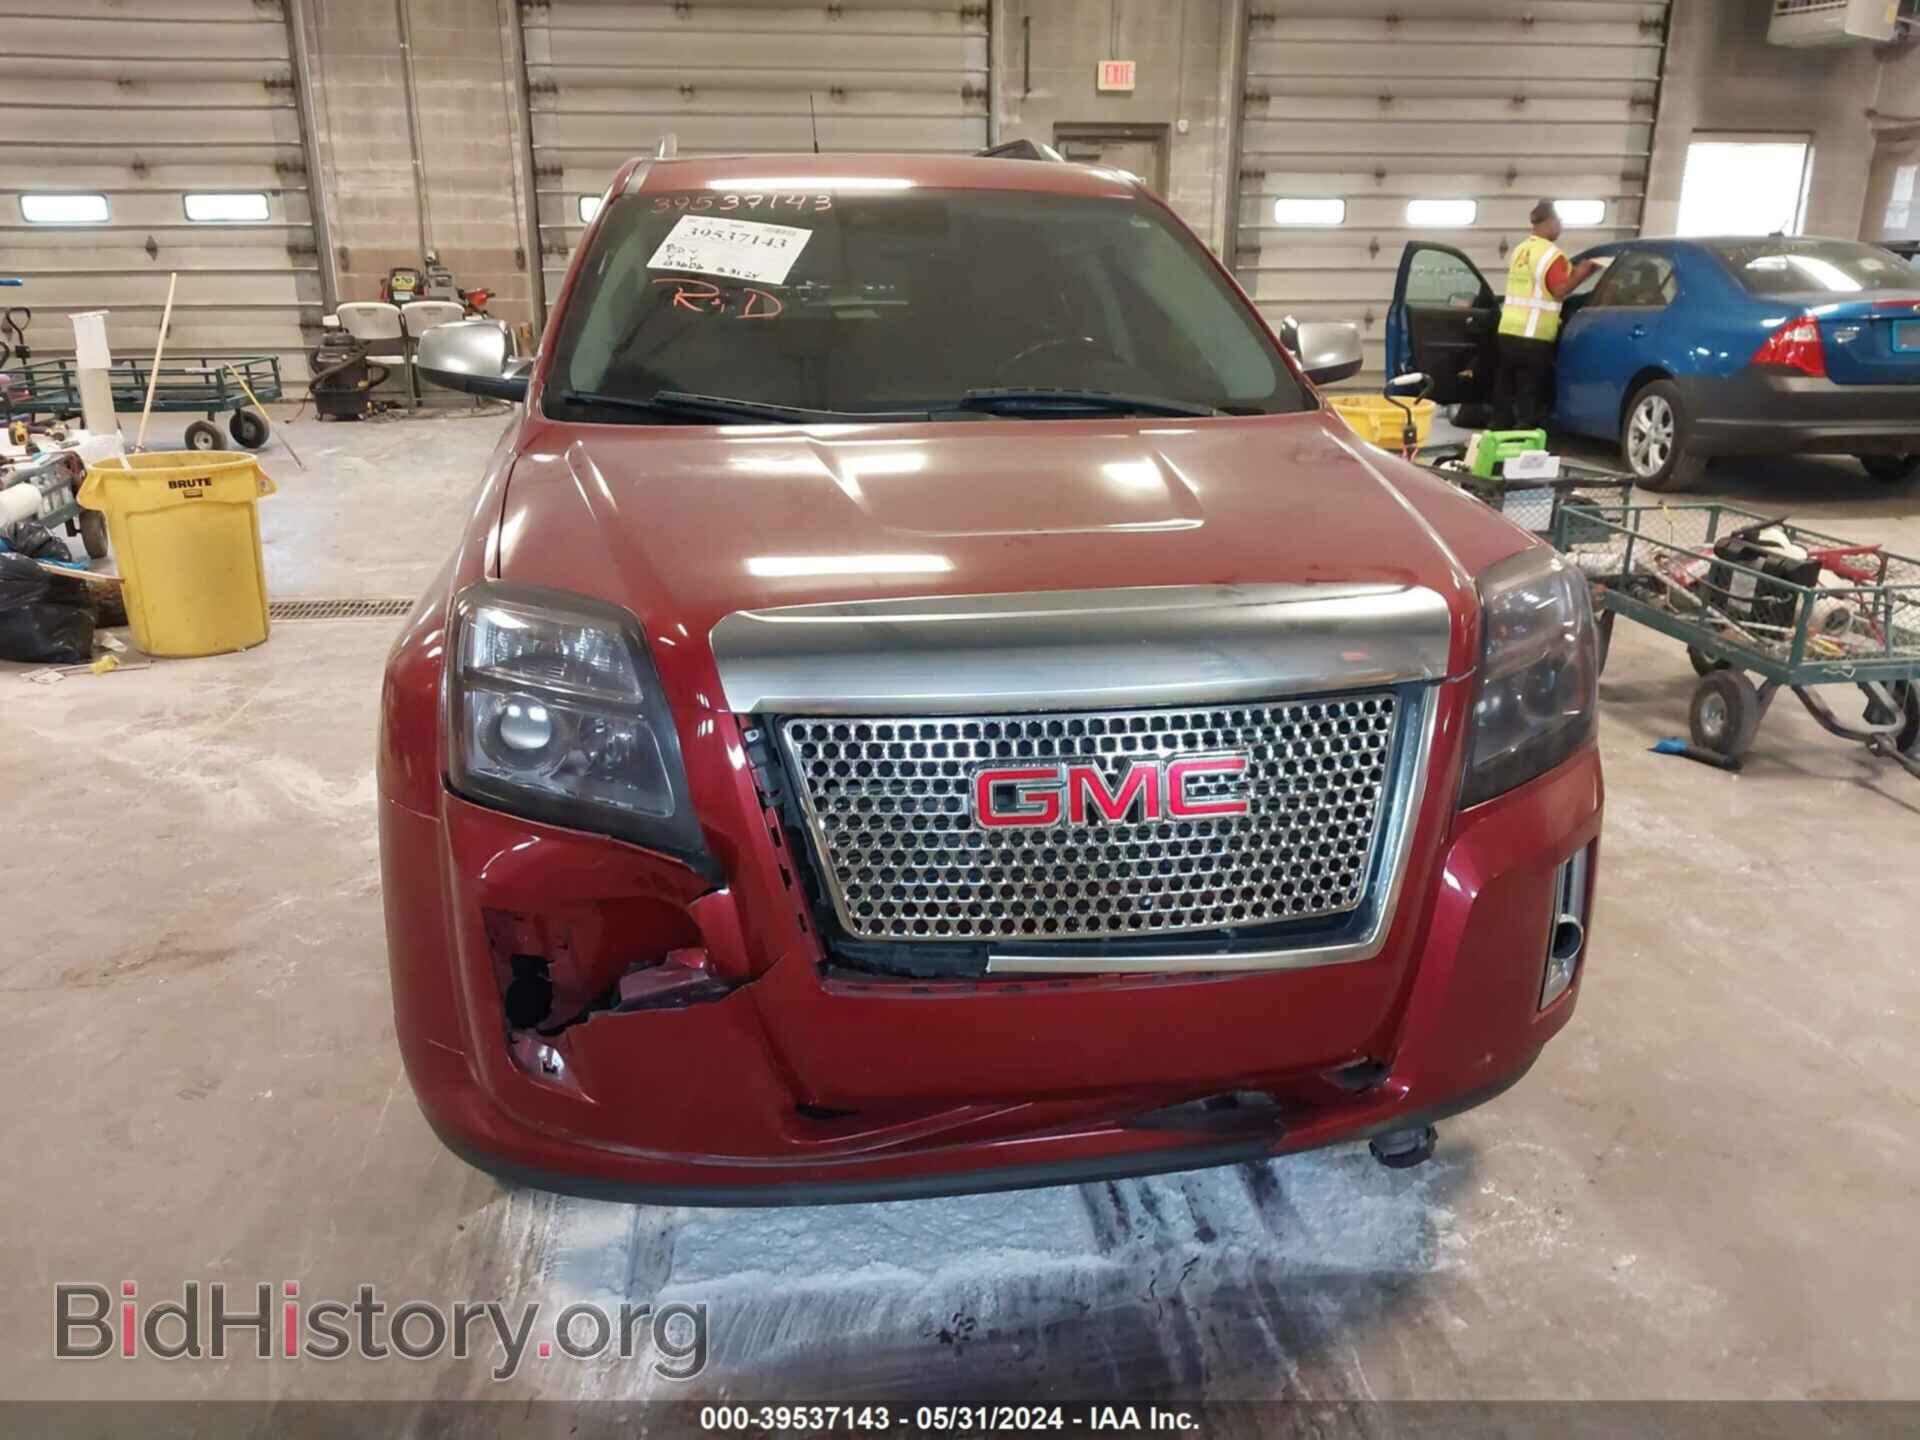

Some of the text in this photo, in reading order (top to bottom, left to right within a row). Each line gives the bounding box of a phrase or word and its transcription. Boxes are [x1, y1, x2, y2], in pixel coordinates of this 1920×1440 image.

[1104, 64, 1133, 85] EXIT
[651, 194, 832, 213] 39537143
[168, 477, 212, 489] BRUTE
[974, 753, 1250, 829] GMC
